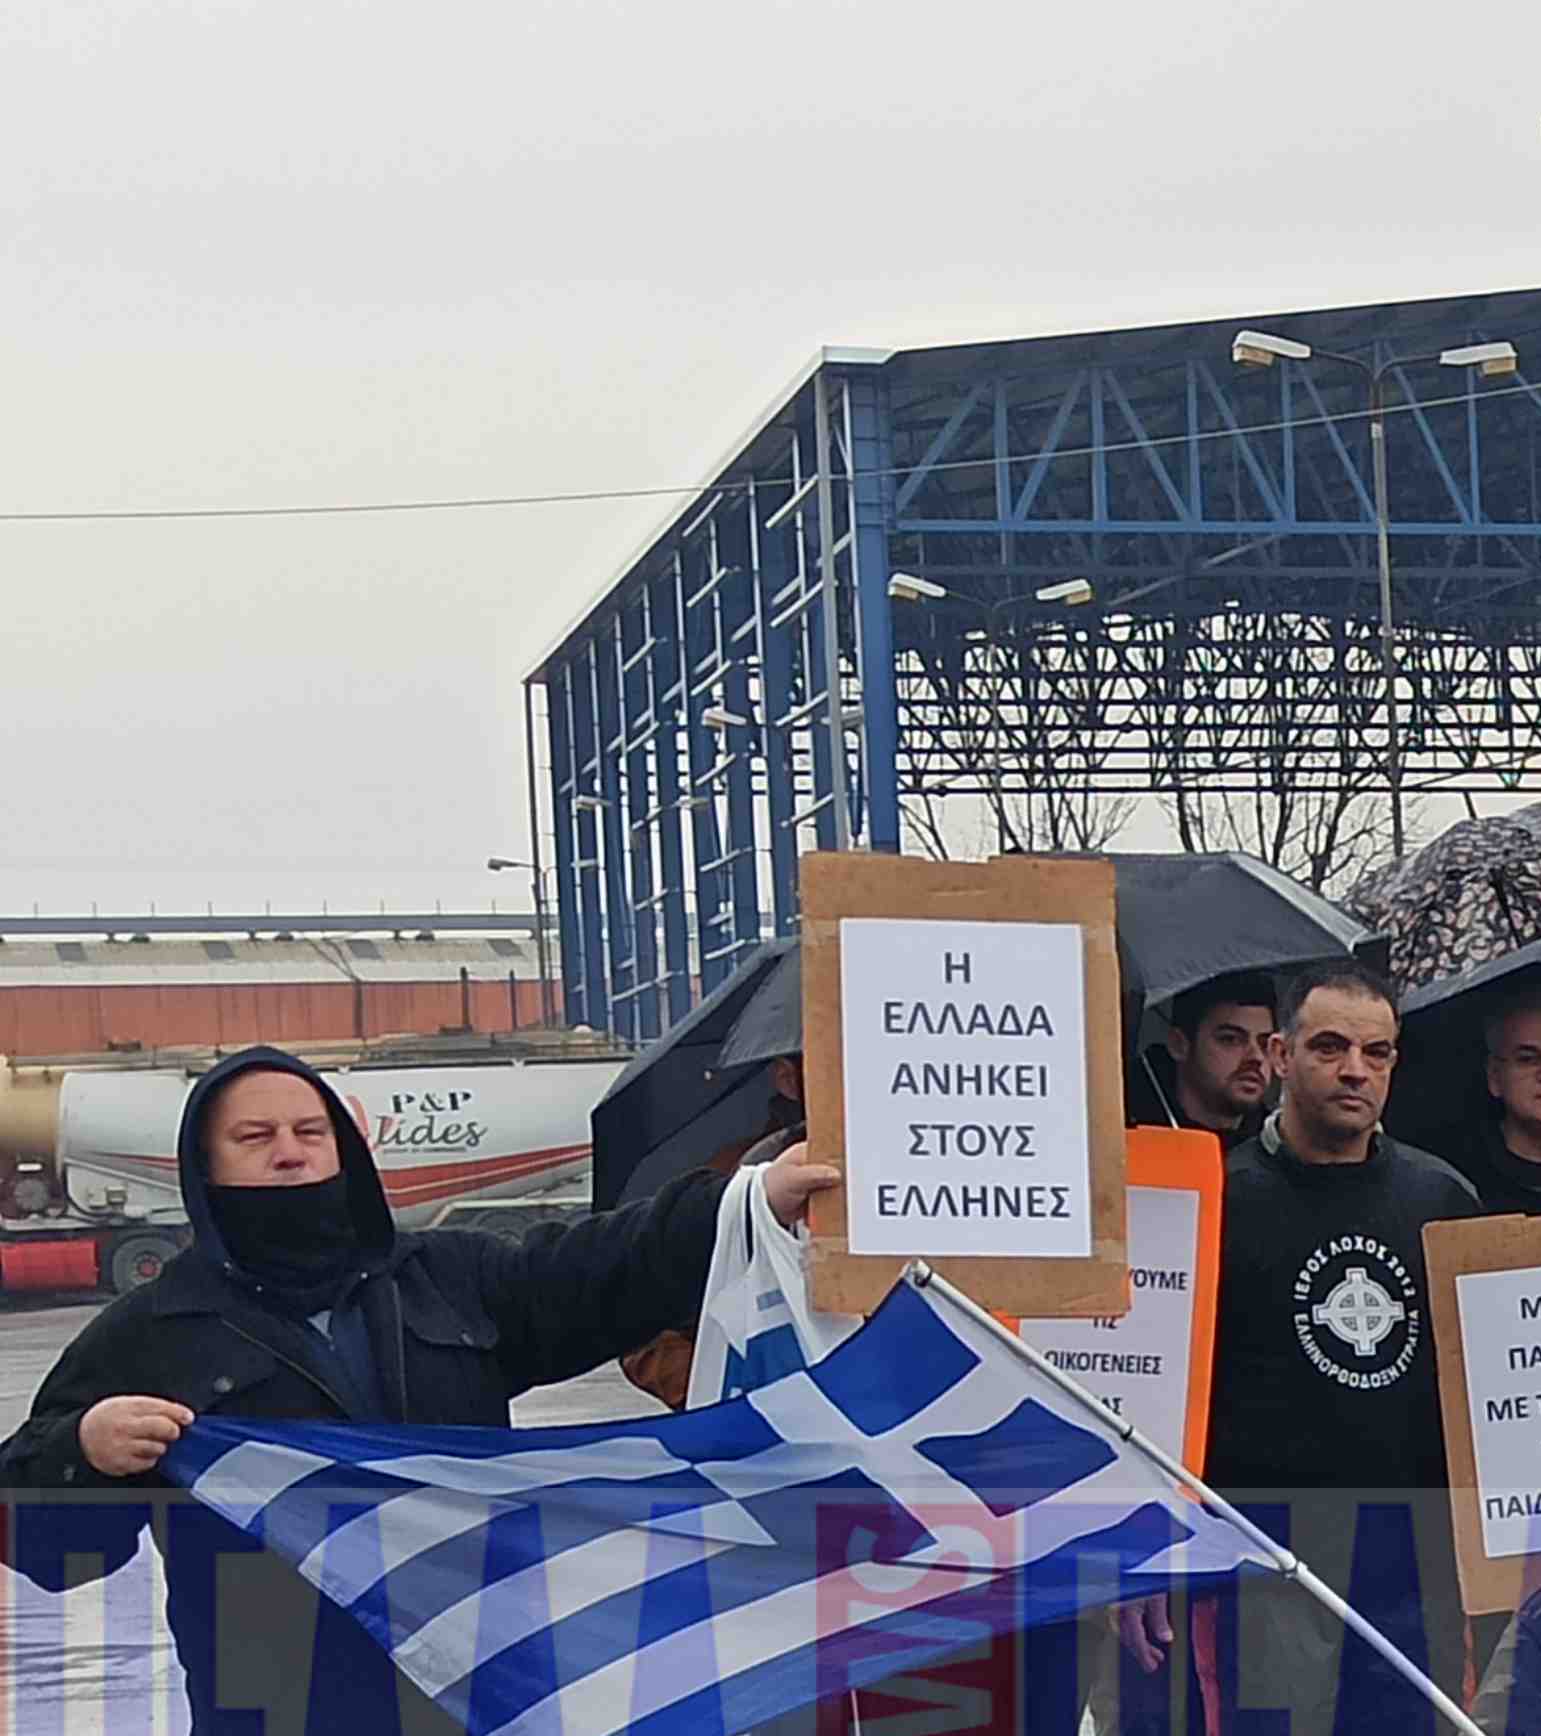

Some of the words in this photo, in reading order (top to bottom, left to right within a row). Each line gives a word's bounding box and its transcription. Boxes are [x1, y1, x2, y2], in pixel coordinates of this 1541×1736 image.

[945, 952, 971, 984] Η
[884, 1001, 1054, 1037] ΕΛΛΑΔΑ
[891, 1062, 1047, 1097] ΑΝΗΚΕΙ
[391, 1090, 472, 1113] P&P
[909, 1124, 1035, 1157] ΣΤΟΥΣ
[878, 1184, 1070, 1218] ΕΛΛΗΝΕΣ
[1129, 1268, 1188, 1290] ΟΥΜΕ
[1293, 1248, 1329, 1301] ΙΕΡΟΣ
[1329, 1235, 1388, 1261] ΛΟΧΟΣ
[1044, 1350, 1163, 1375] ΟΙΚΟΓΕΝΕΙΕΣ
[1486, 1396, 1529, 1422] ΜΕ
